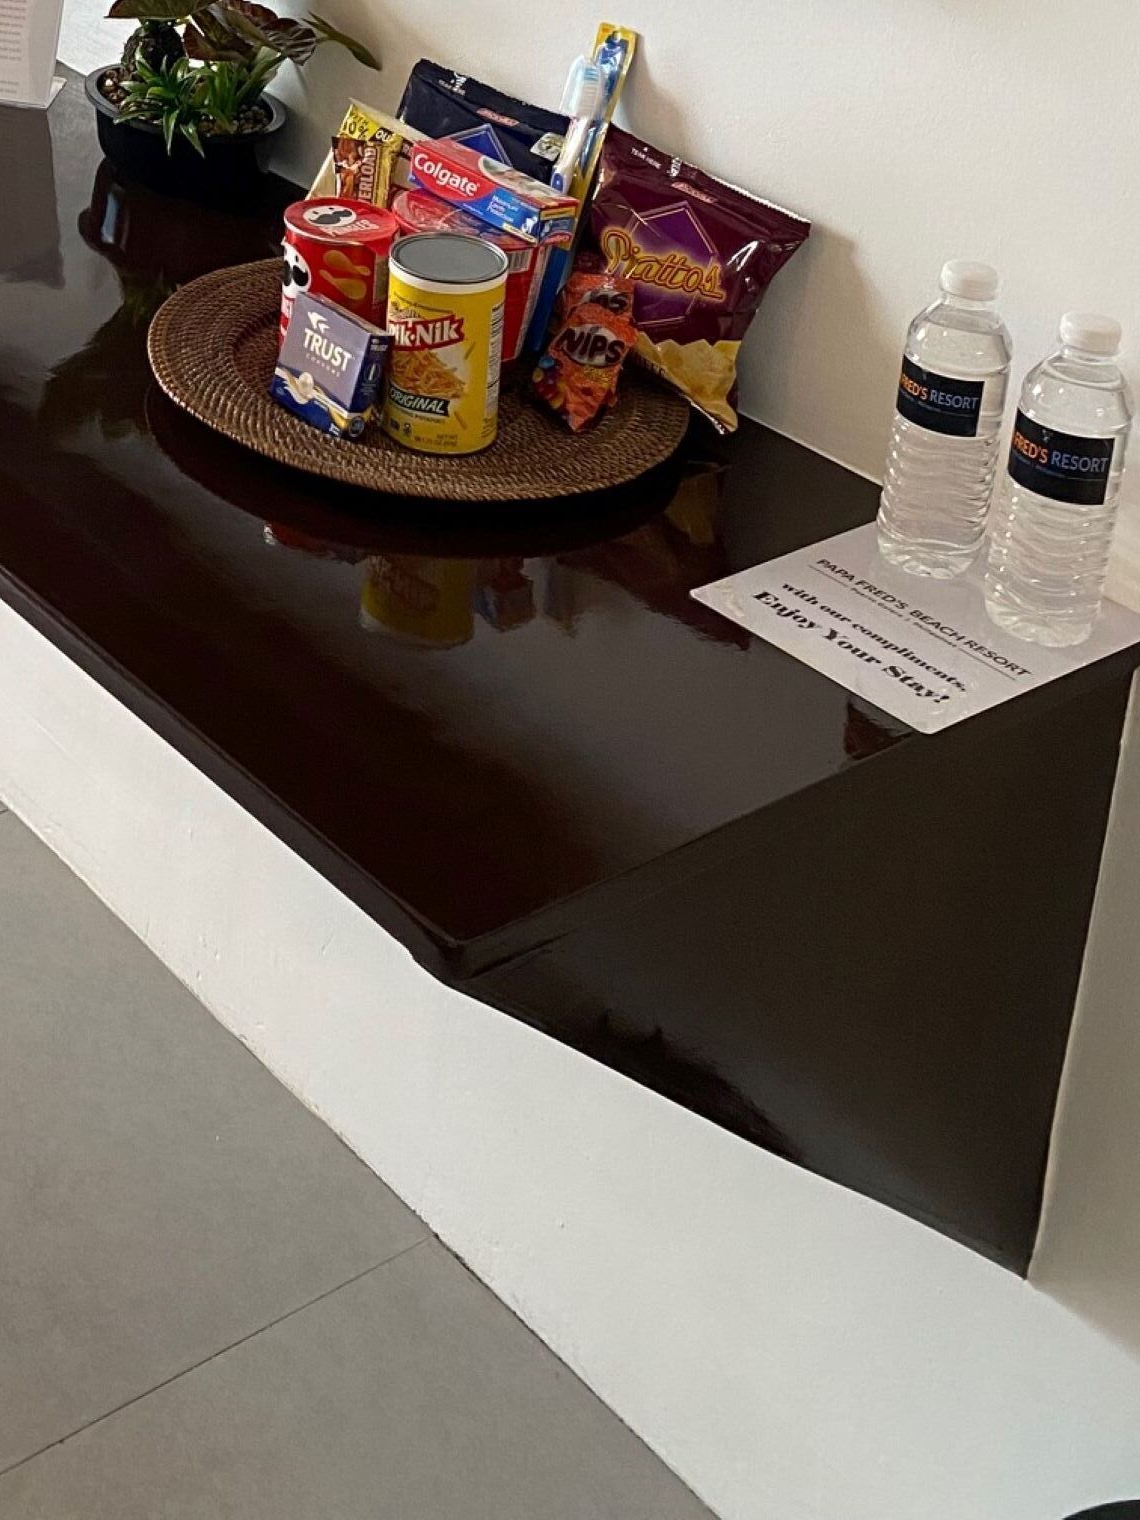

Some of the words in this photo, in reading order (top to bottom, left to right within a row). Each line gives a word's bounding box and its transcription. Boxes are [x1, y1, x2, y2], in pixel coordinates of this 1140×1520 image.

[358, 146, 377, 200] ERLOAD
[414, 153, 478, 197] Colgate
[603, 229, 725, 300] Piattos
[304, 327, 353, 372] TRUST
[560, 328, 626, 364] NIPS
[390, 387, 446, 414] ORIGINAL
[930, 388, 980, 409] RESORT
[1051, 450, 1110, 473] RESORT
[782, 583, 819, 606] with
[819, 605, 853, 623] our
[816, 558, 855, 582] PAPA
[855, 579, 909, 610] FRED'S
[909, 609, 967, 642] BEACH
[964, 639, 1033, 676] RESORT
[752, 591, 823, 630] Enjoy
[822, 628, 882, 664] Your
[881, 665, 951, 704] Stay!
